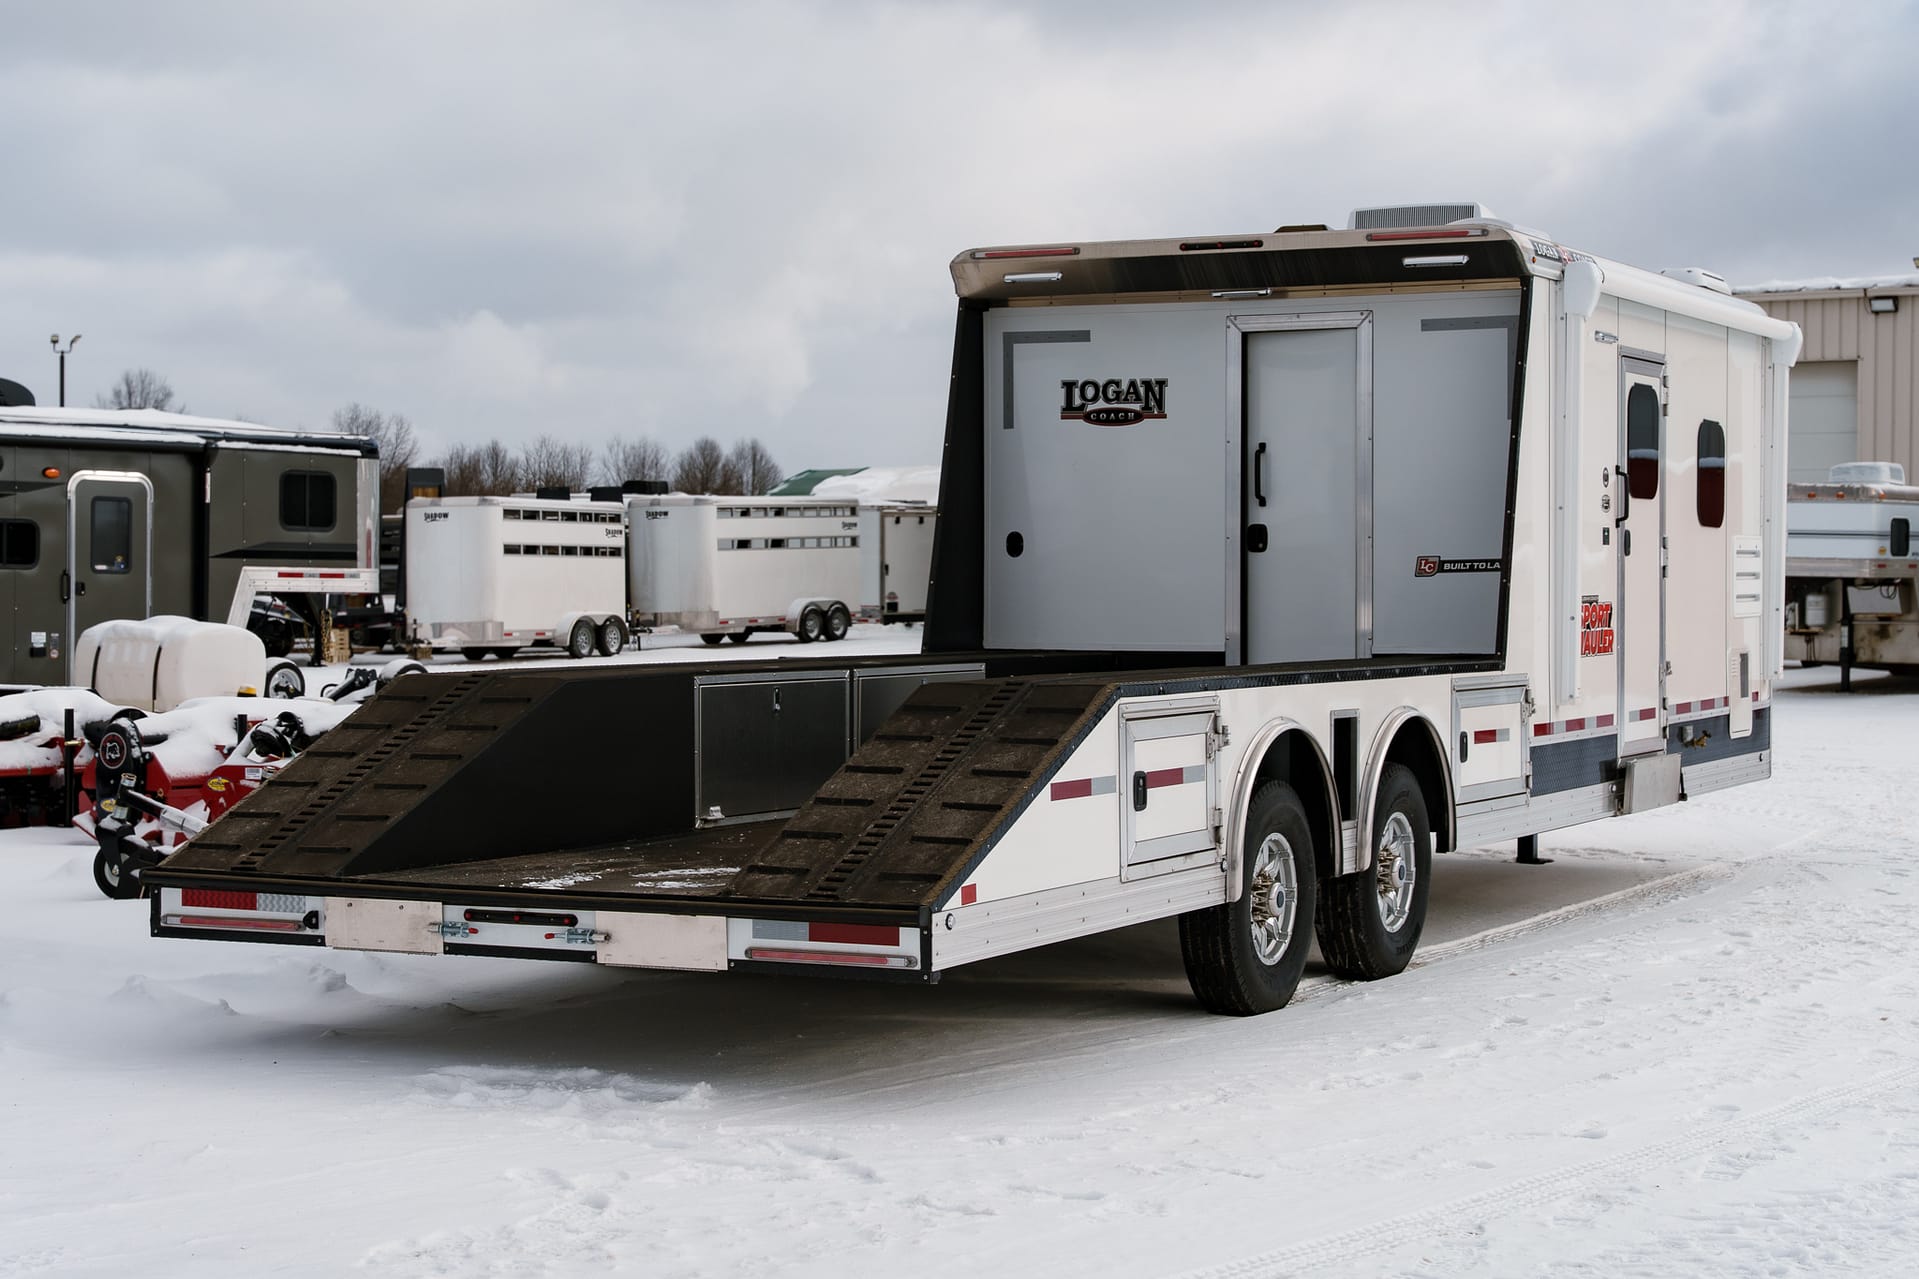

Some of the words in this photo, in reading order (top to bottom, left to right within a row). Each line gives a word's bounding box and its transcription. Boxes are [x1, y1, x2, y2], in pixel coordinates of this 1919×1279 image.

[1061, 378, 1168, 413] LOGAN
[1090, 412, 1135, 420] COACH
[1443, 562, 1472, 570] BUILT
[1581, 602, 1612, 629] PORT
